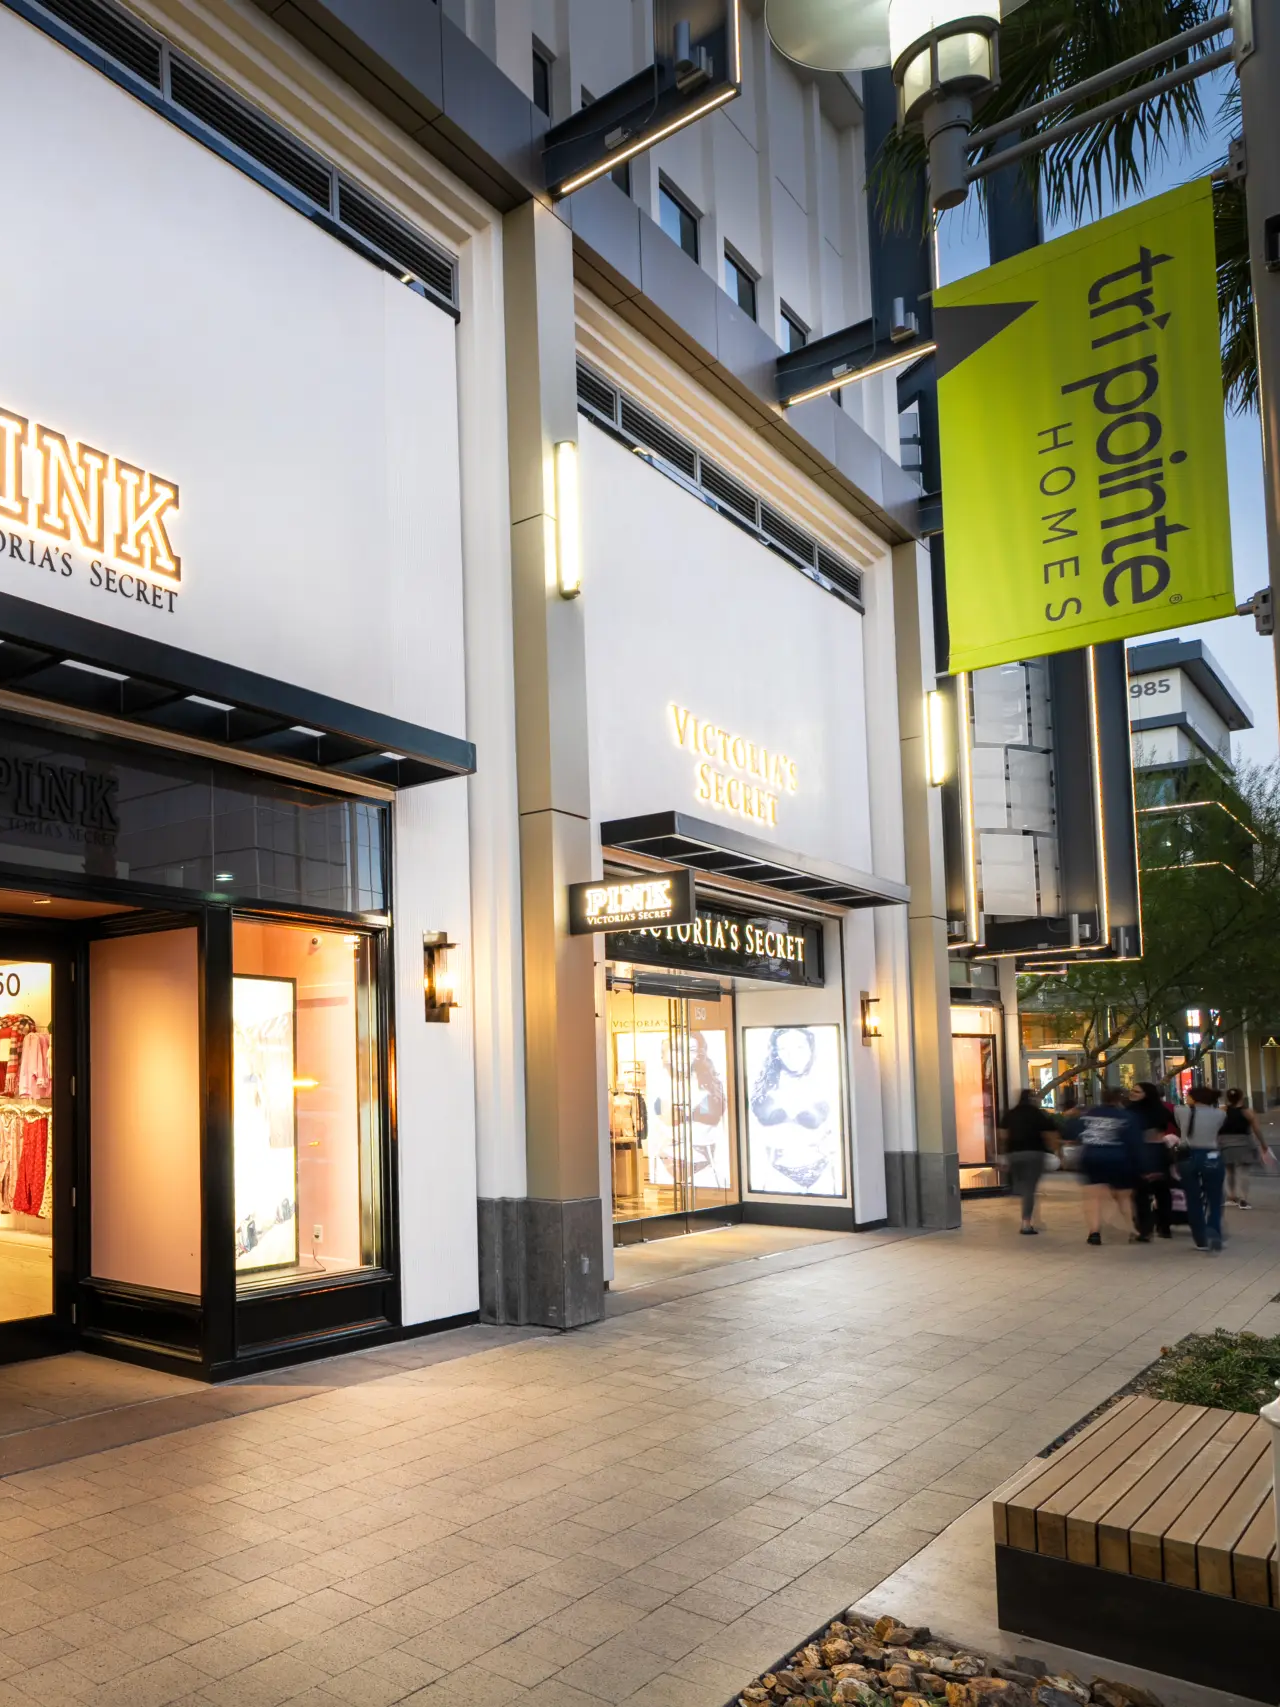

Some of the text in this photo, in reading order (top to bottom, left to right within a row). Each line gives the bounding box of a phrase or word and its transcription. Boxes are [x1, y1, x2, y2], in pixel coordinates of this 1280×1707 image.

[1037, 421, 1082, 622] HOMES
[89, 559, 178, 614] SECRET
[1129, 678, 1171, 699] 985
[670, 703, 799, 792] VICTORIA'S
[699, 763, 779, 825] SECRET
[68, 826, 117, 847] SECRET
[585, 879, 672, 917] PINK
[586, 909, 672, 925] VICTORIA'S SECRET
[745, 923, 805, 962] SECRET
